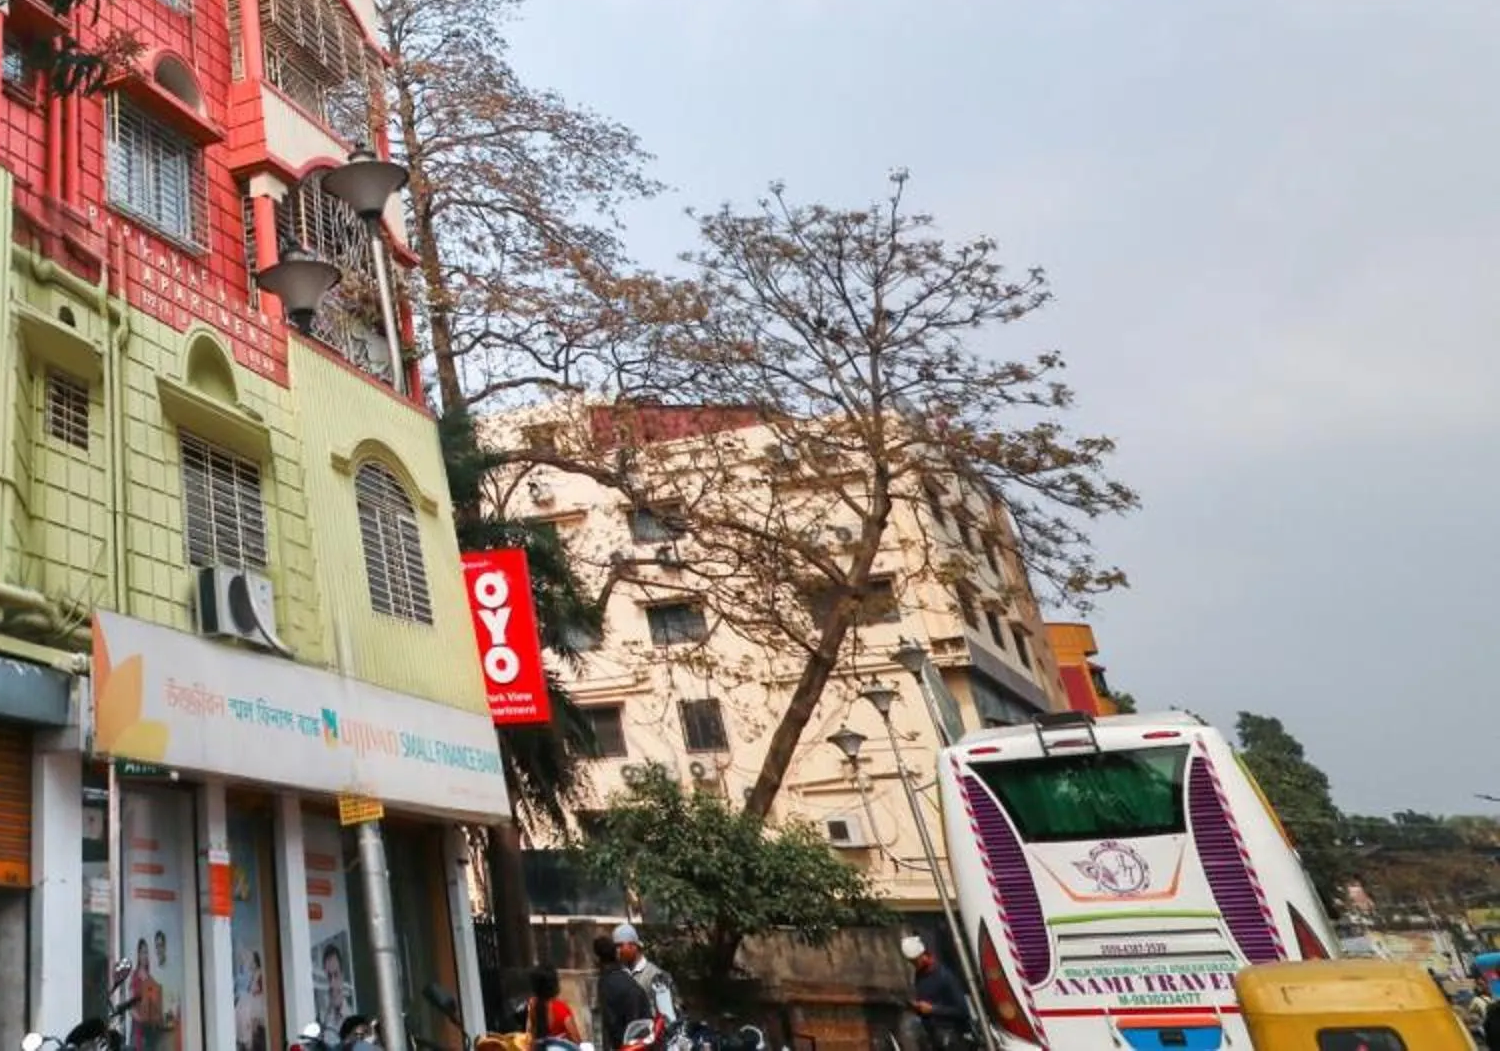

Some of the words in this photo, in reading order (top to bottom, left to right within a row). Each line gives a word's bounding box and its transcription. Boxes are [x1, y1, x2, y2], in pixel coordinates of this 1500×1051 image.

[474, 571, 521, 684] OYO
[507, 691, 534, 703] View
[490, 704, 537, 717] artment
[399, 732, 437, 763] SMALL
[1054, 976, 1136, 996] ANAMI
